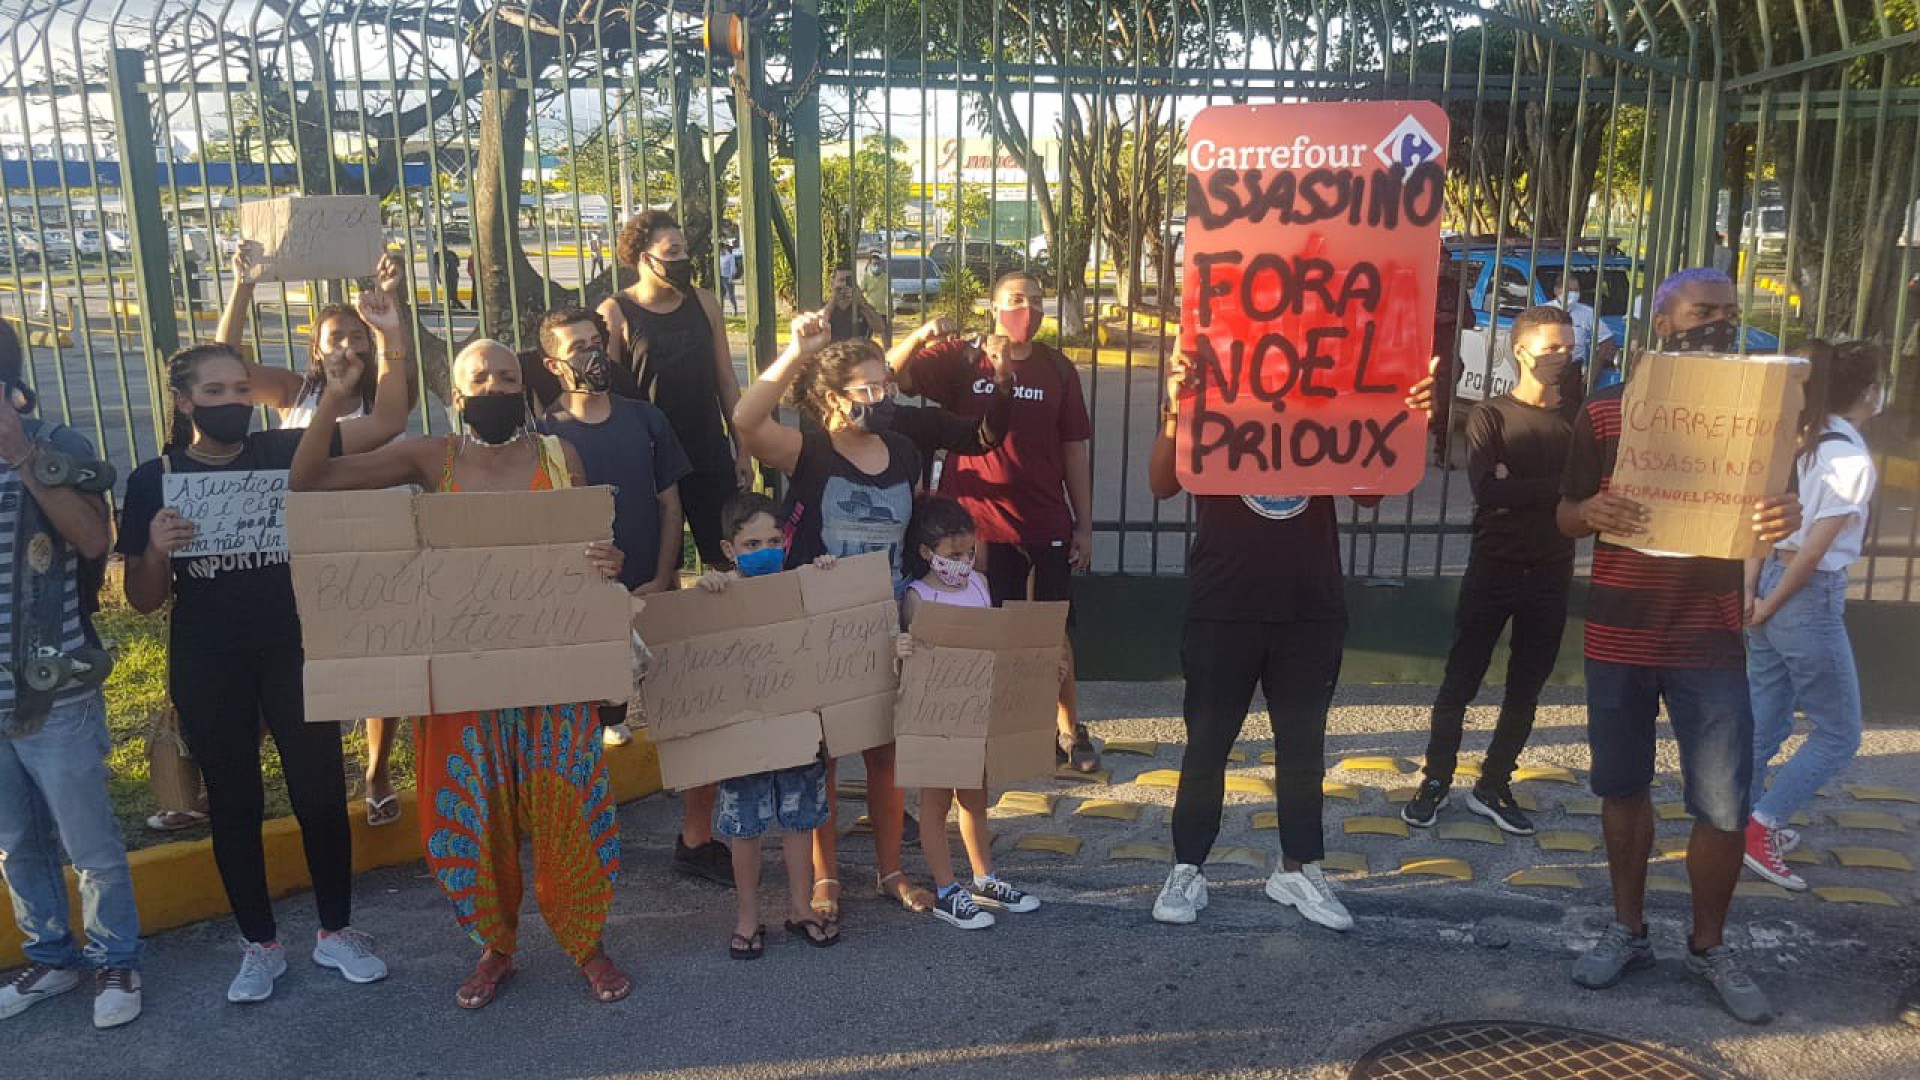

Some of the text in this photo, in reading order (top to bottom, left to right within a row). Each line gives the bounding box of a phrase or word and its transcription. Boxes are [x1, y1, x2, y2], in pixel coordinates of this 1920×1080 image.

[1191, 135, 1368, 172] Carrefour
[1193, 250, 1383, 328] FORA
[972, 378, 1044, 401] Coton
[1194, 320, 1398, 404] NOEL
[1191, 402, 1410, 475] PRIOUX
[1619, 447, 1765, 476] ASSASSINO
[315, 555, 444, 612] Black
